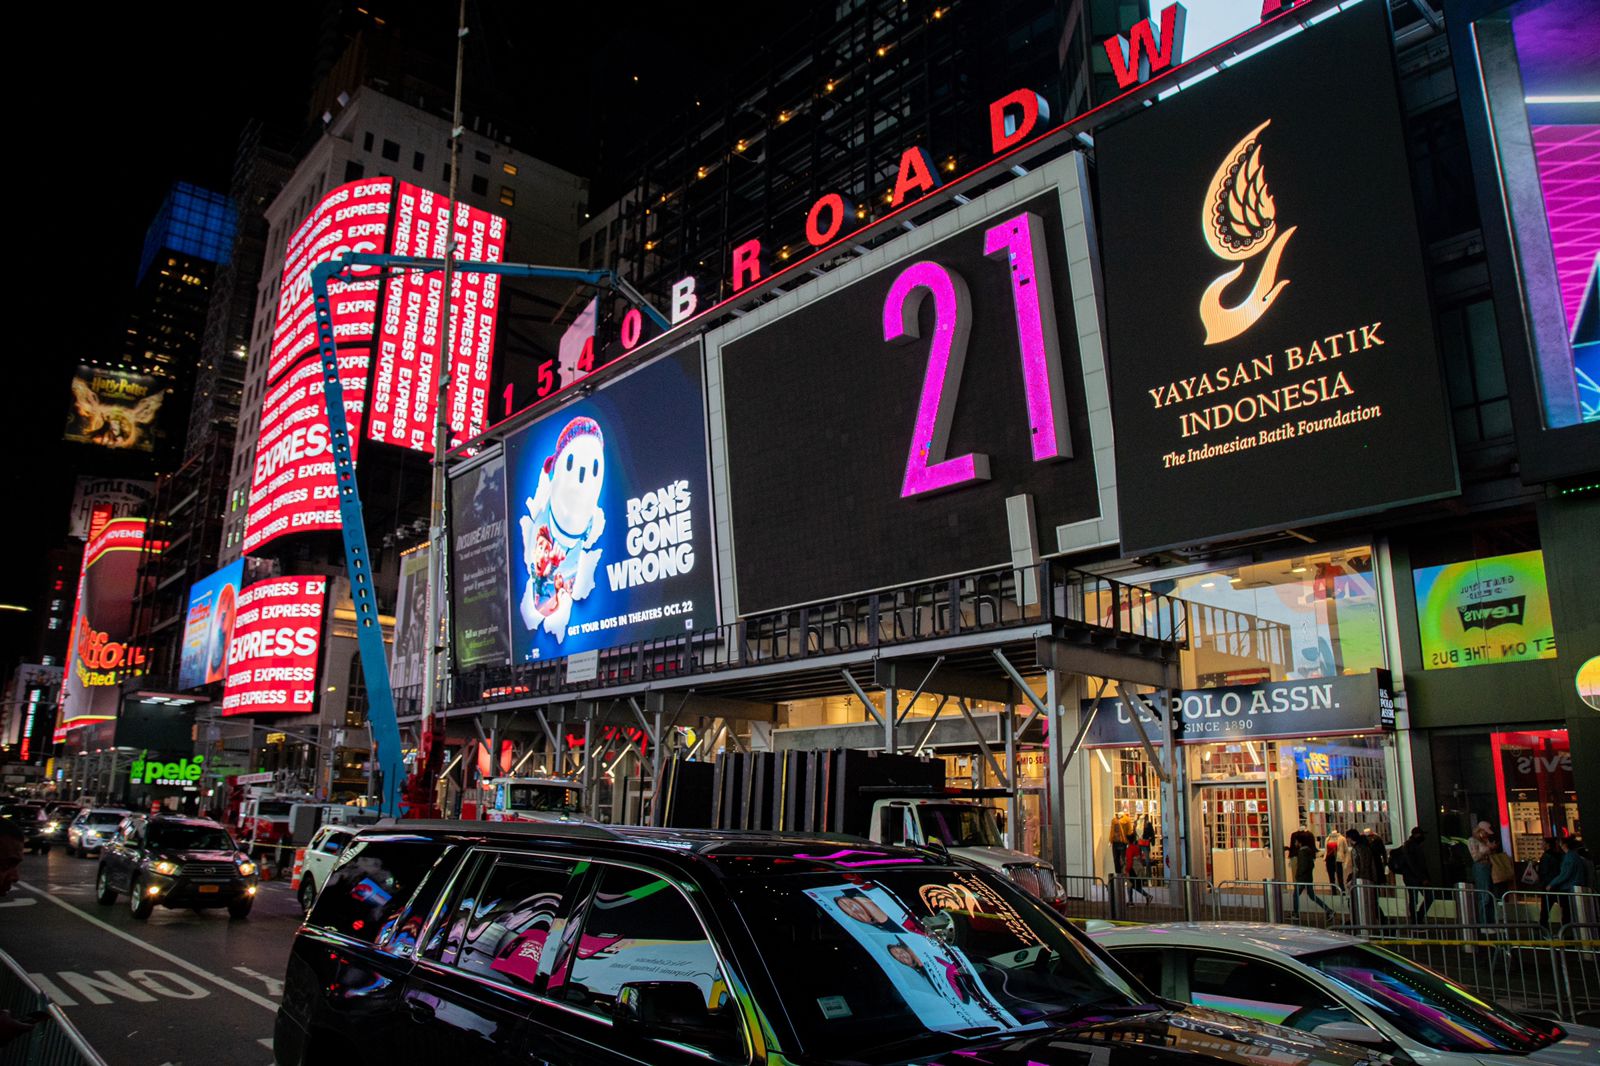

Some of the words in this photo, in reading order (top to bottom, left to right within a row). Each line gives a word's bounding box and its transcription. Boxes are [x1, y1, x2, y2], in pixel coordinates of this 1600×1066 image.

[401, 291, 421, 362] EXPRESS
[422, 278, 442, 346] EXPRESS
[460, 290, 479, 357] EXPRESS
[474, 314, 493, 381] EXPRESS
[882, 212, 1072, 499] 21
[1149, 355, 1274, 409] YAYASAN
[1285, 322, 1385, 371] BATIK
[375, 341, 396, 413] EXPRESS
[413, 352, 434, 423] EXPRESS
[451, 362, 470, 432] EXPRESS
[391, 367, 413, 439] EXPRESS
[1179, 371, 1355, 438] INDONESIA
[1163, 450, 1186, 468] The
[1188, 436, 1257, 463] Indonesian
[1259, 424, 1296, 447] Batik
[1298, 403, 1383, 436] Foundation
[626, 480, 691, 527] RON'S
[626, 511, 693, 556] GONE
[606, 543, 695, 592] WRONG
[253, 582, 299, 602] EXPRESS
[262, 603, 321, 620] EXPRESS
[568, 625, 580, 636] GET
[581, 622, 600, 634] YOUR
[600, 618, 617, 631] BOTS
[618, 615, 627, 626] IN
[628, 607, 662, 624] THEATERS
[663, 604, 682, 617] OCT.
[682, 600, 693, 613] 22
[228, 626, 318, 666] EXPRESS
[89, 671, 116, 686] Red
[241, 690, 287, 706] EXPRESS
[253, 667, 314, 682] EXPRESS
[1248, 684, 1340, 716] ASSN.
[1184, 720, 1220, 733] SINCE
[1225, 719, 1253, 732] 1890
[145, 755, 204, 784] pelé
[156, 778, 193, 786] SOCCER
